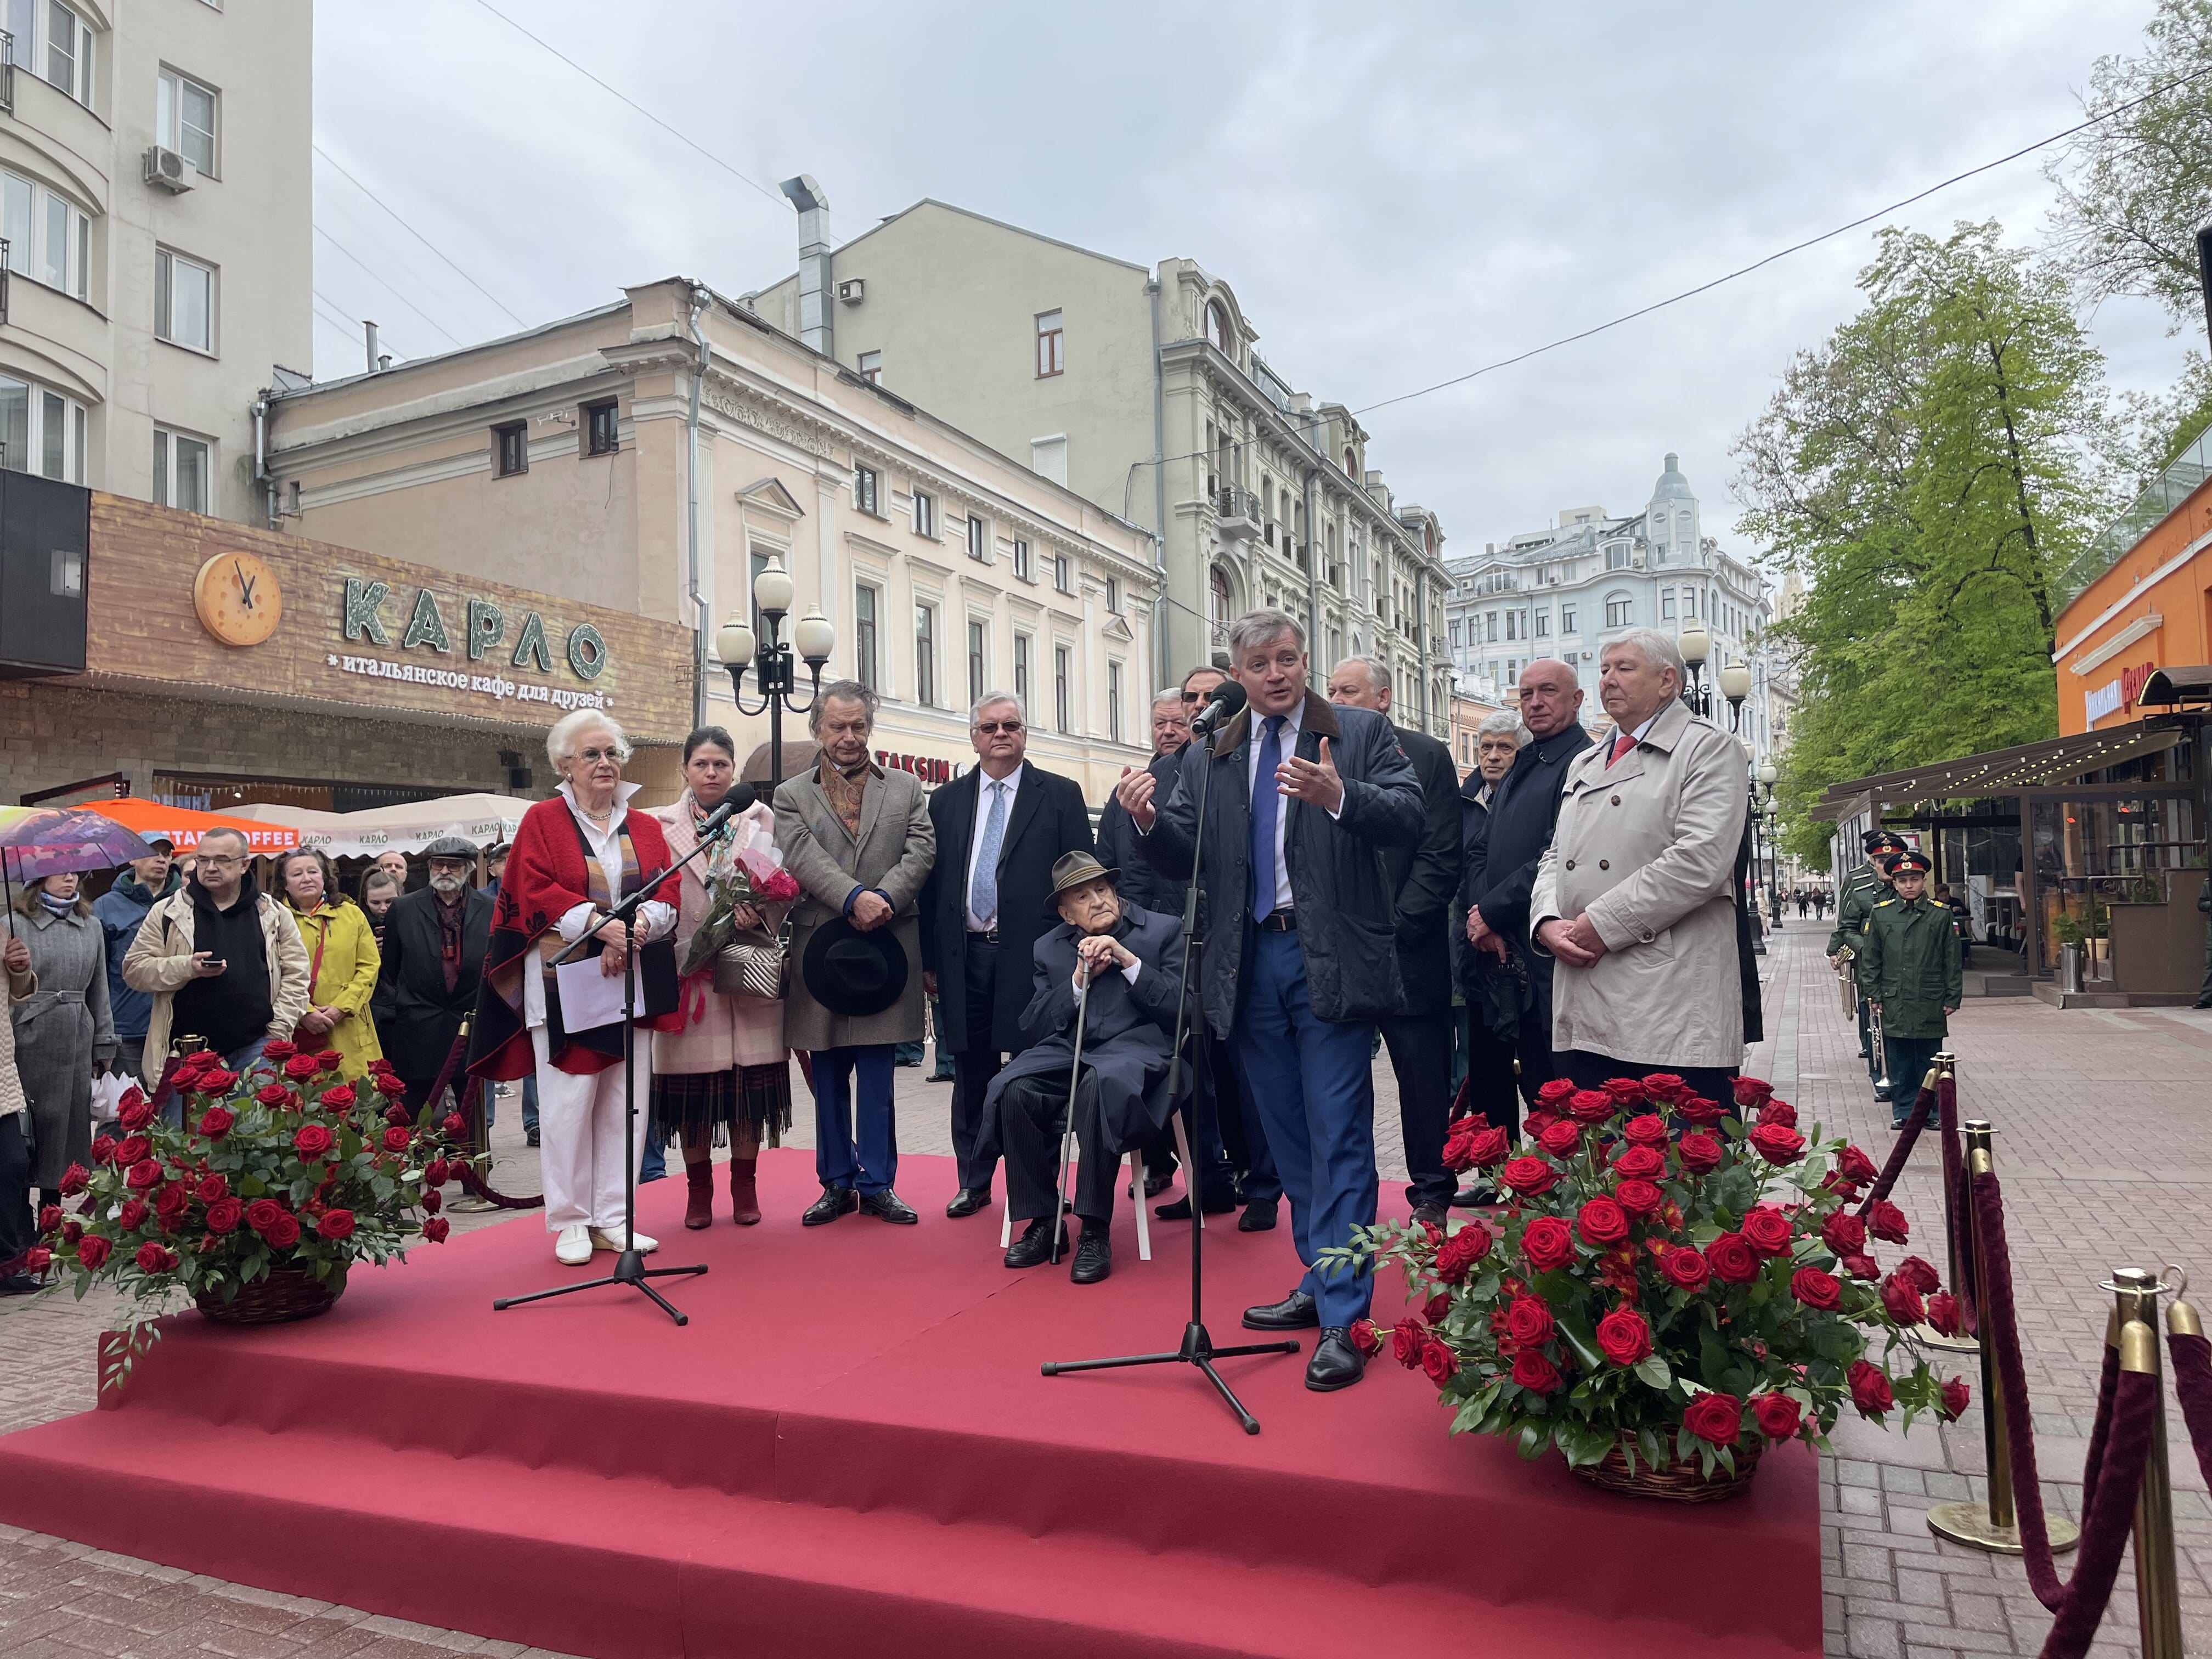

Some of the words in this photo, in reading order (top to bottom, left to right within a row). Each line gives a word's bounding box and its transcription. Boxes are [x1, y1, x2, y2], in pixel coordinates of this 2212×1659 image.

[343, 578, 606, 680] КАРЛО
[341, 655, 468, 690] итальянское
[471, 674, 515, 698] кафе
[518, 684, 548, 702] для
[551, 689, 604, 710] друзей
[876, 751, 950, 783] TAKSIM
[471, 822, 500, 835] КАРЛО
[503, 824, 517, 833] КАР
[163, 831, 207, 846] STA
[302, 835, 332, 844] КАРЛО
[359, 834, 388, 844] КАРЛО
[415, 830, 444, 841] КАРЛО
